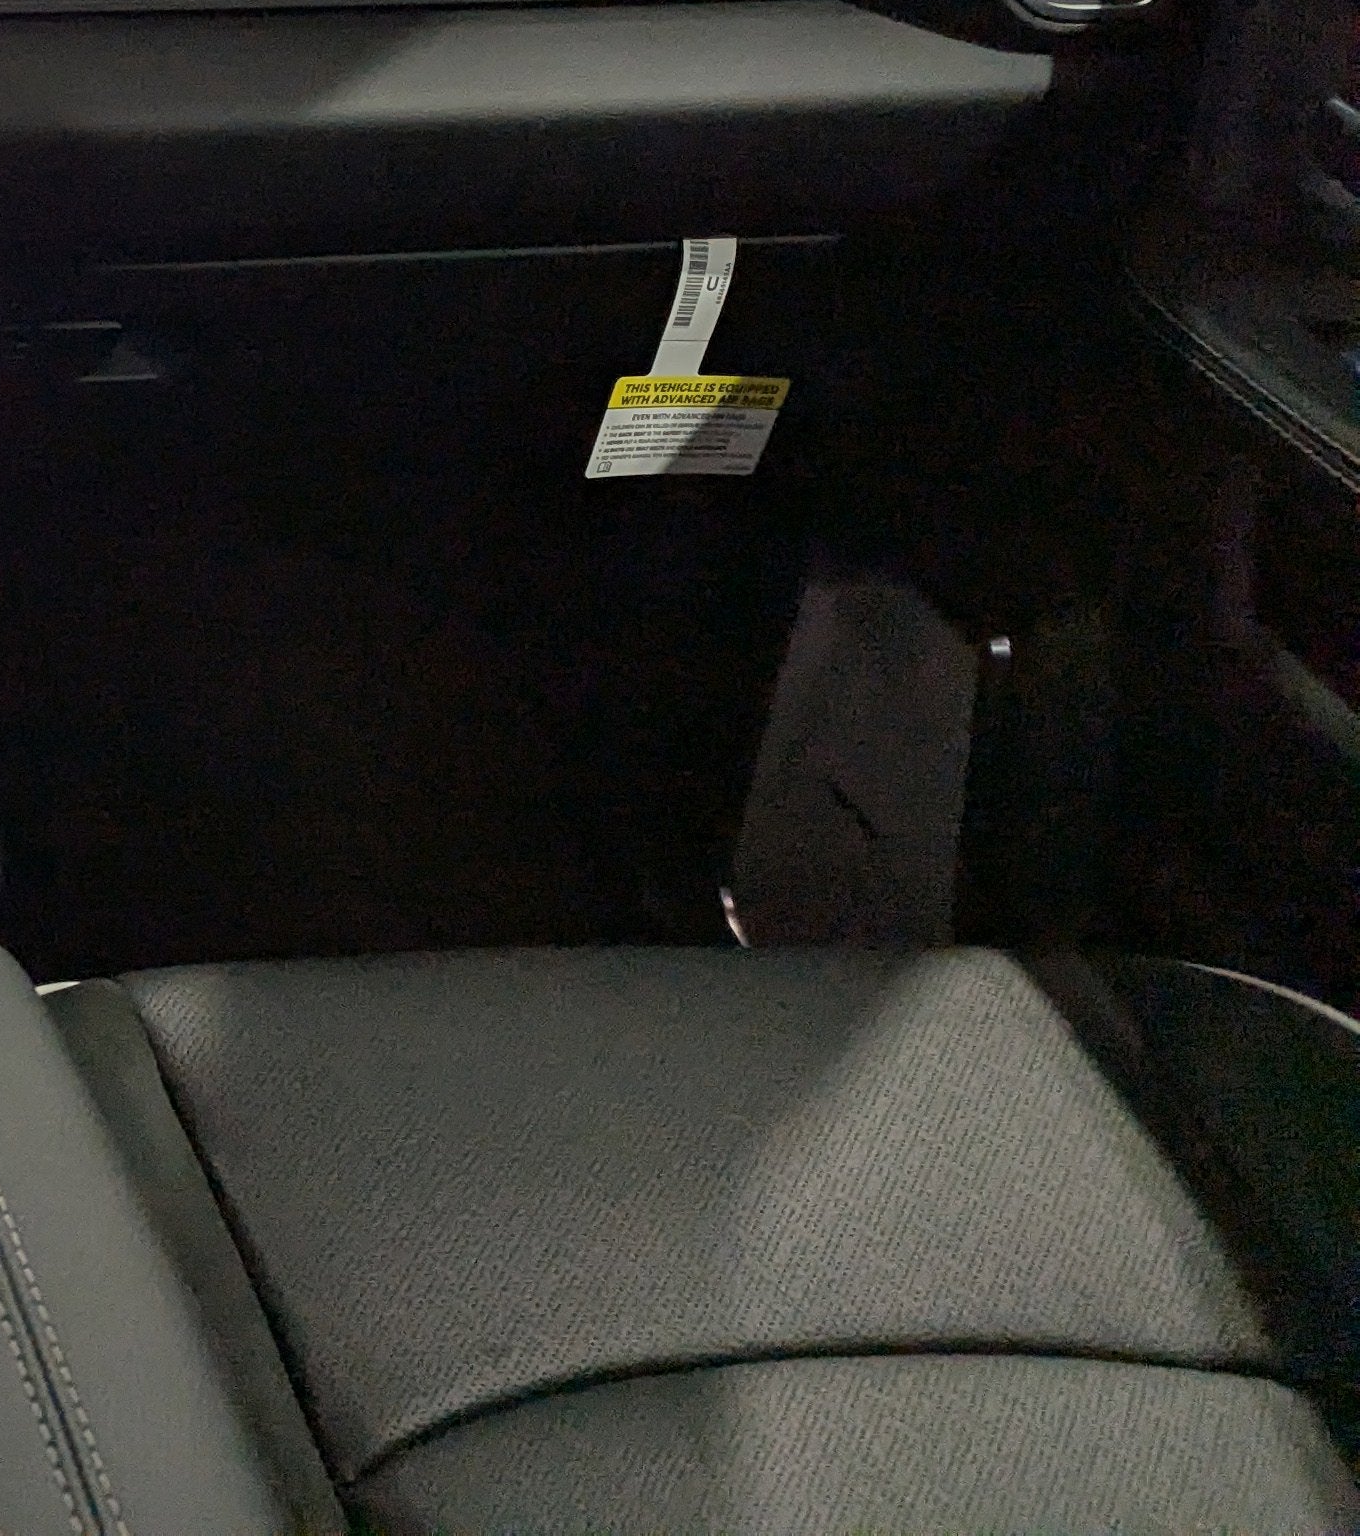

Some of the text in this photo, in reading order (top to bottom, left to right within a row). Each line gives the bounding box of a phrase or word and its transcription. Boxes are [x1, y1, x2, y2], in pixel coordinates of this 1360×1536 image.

[706, 276, 720, 292] U
[625, 384, 651, 393] THIS
[653, 383, 701, 393] VEHICLE
[704, 383, 716, 392] IS
[621, 395, 650, 405] WITH
[652, 395, 716, 404] ADVANCED
